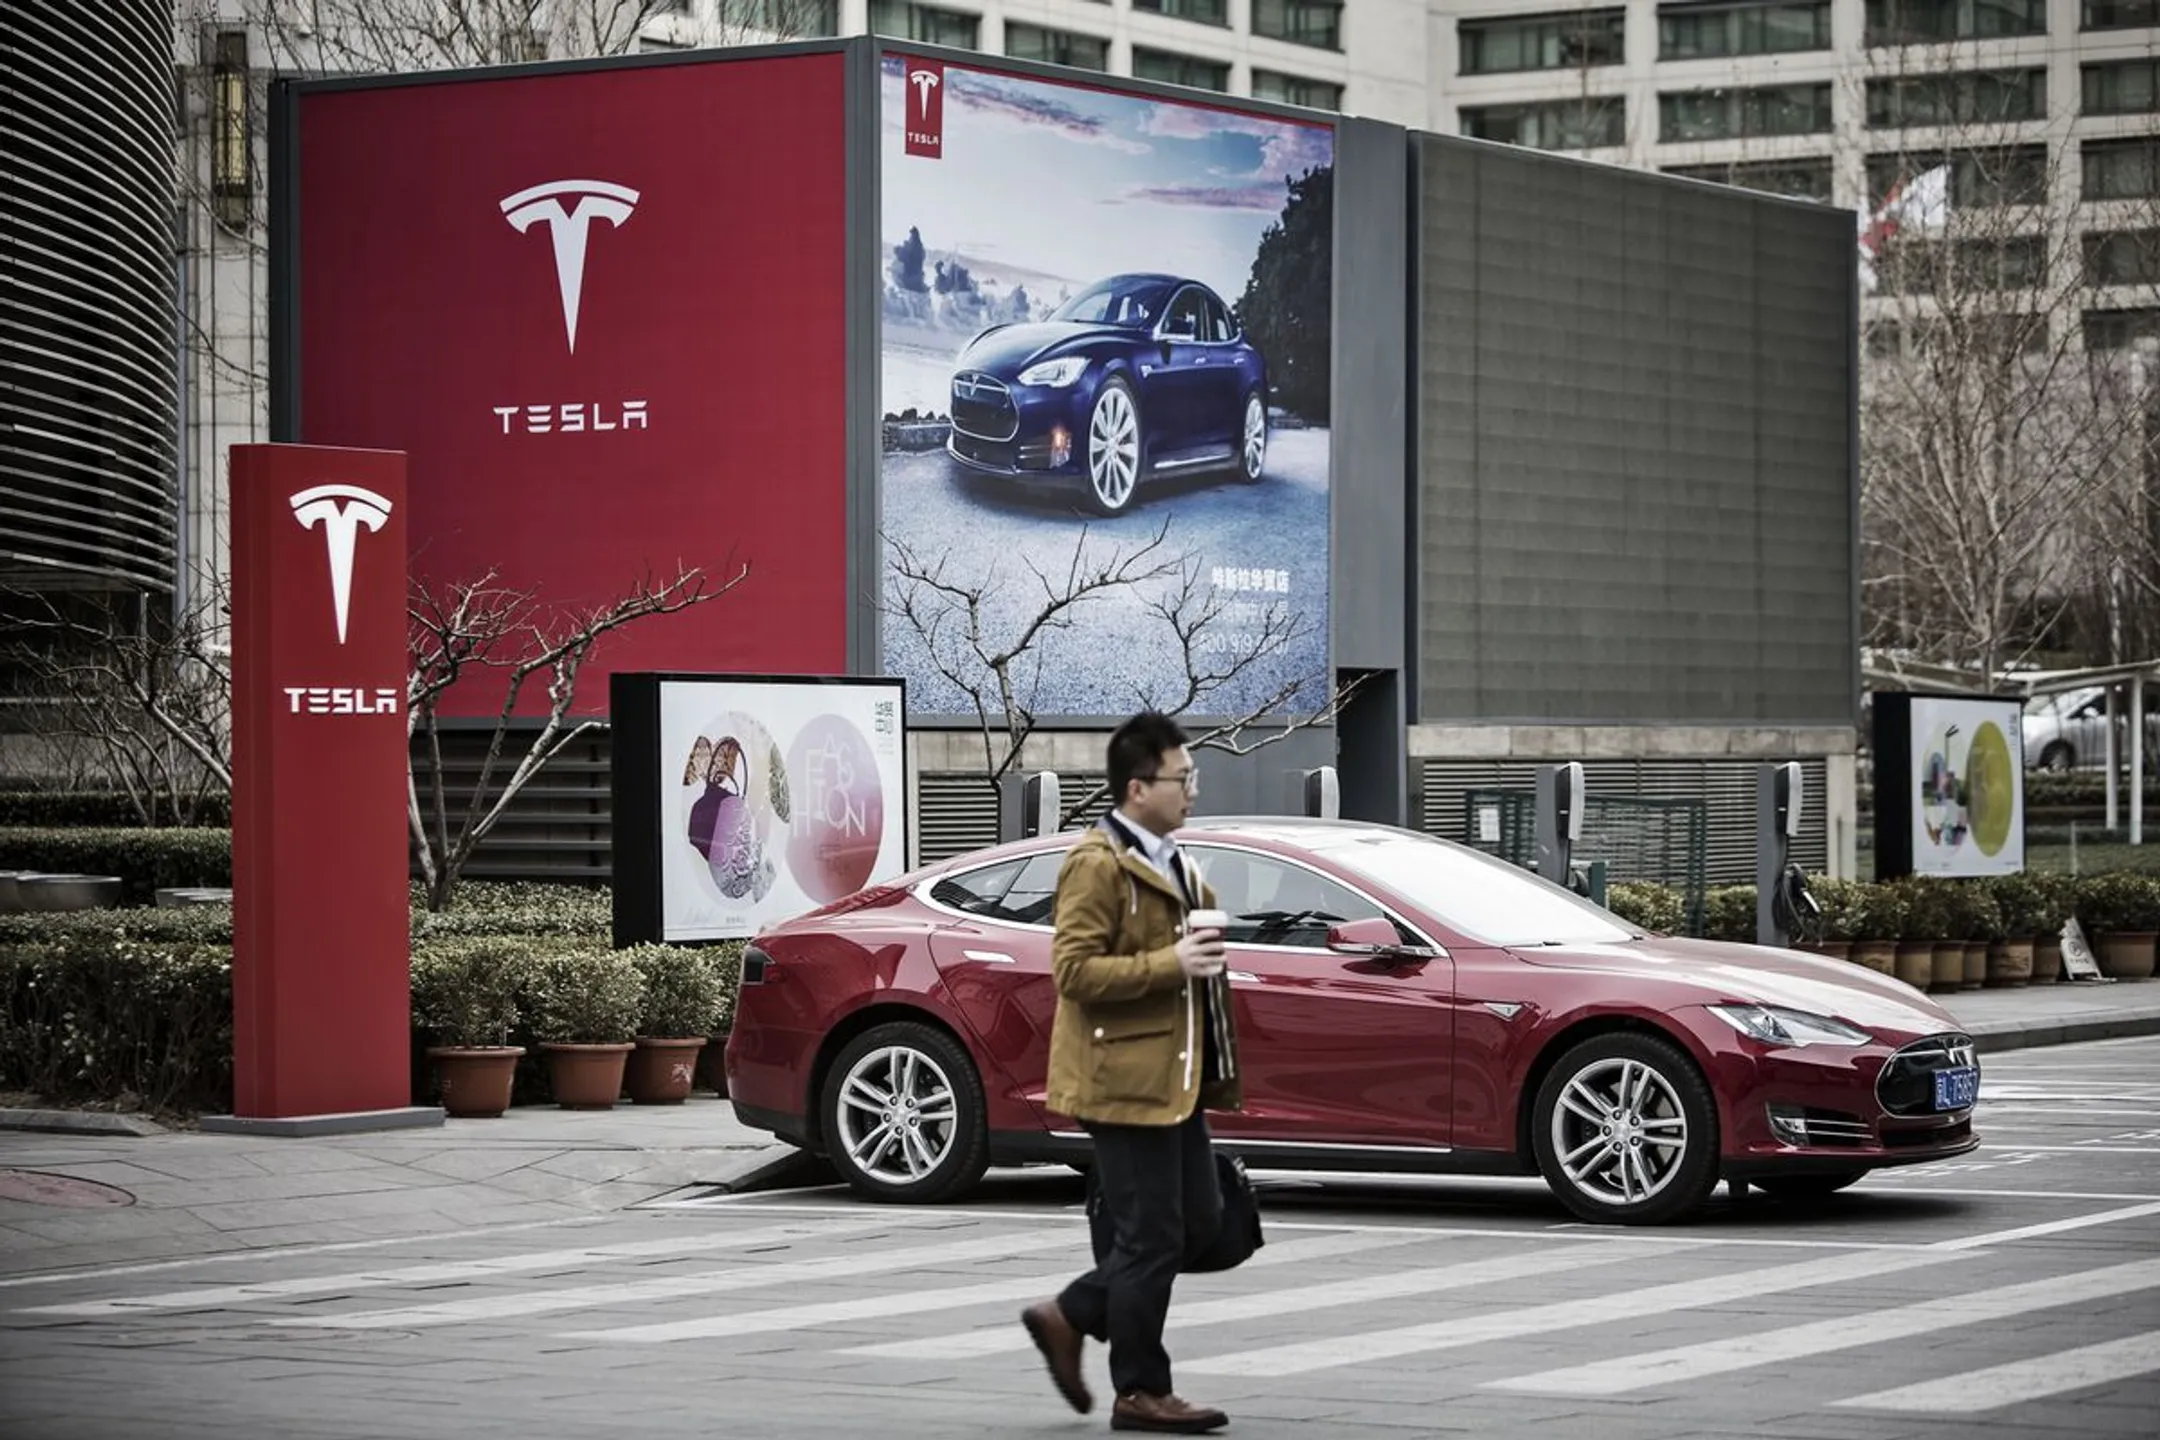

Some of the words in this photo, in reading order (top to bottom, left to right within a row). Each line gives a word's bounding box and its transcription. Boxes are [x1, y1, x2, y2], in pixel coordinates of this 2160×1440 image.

[908, 132, 938, 145] TESLA
[493, 401, 647, 434] TESLA
[283, 688, 397, 713] TESLA
